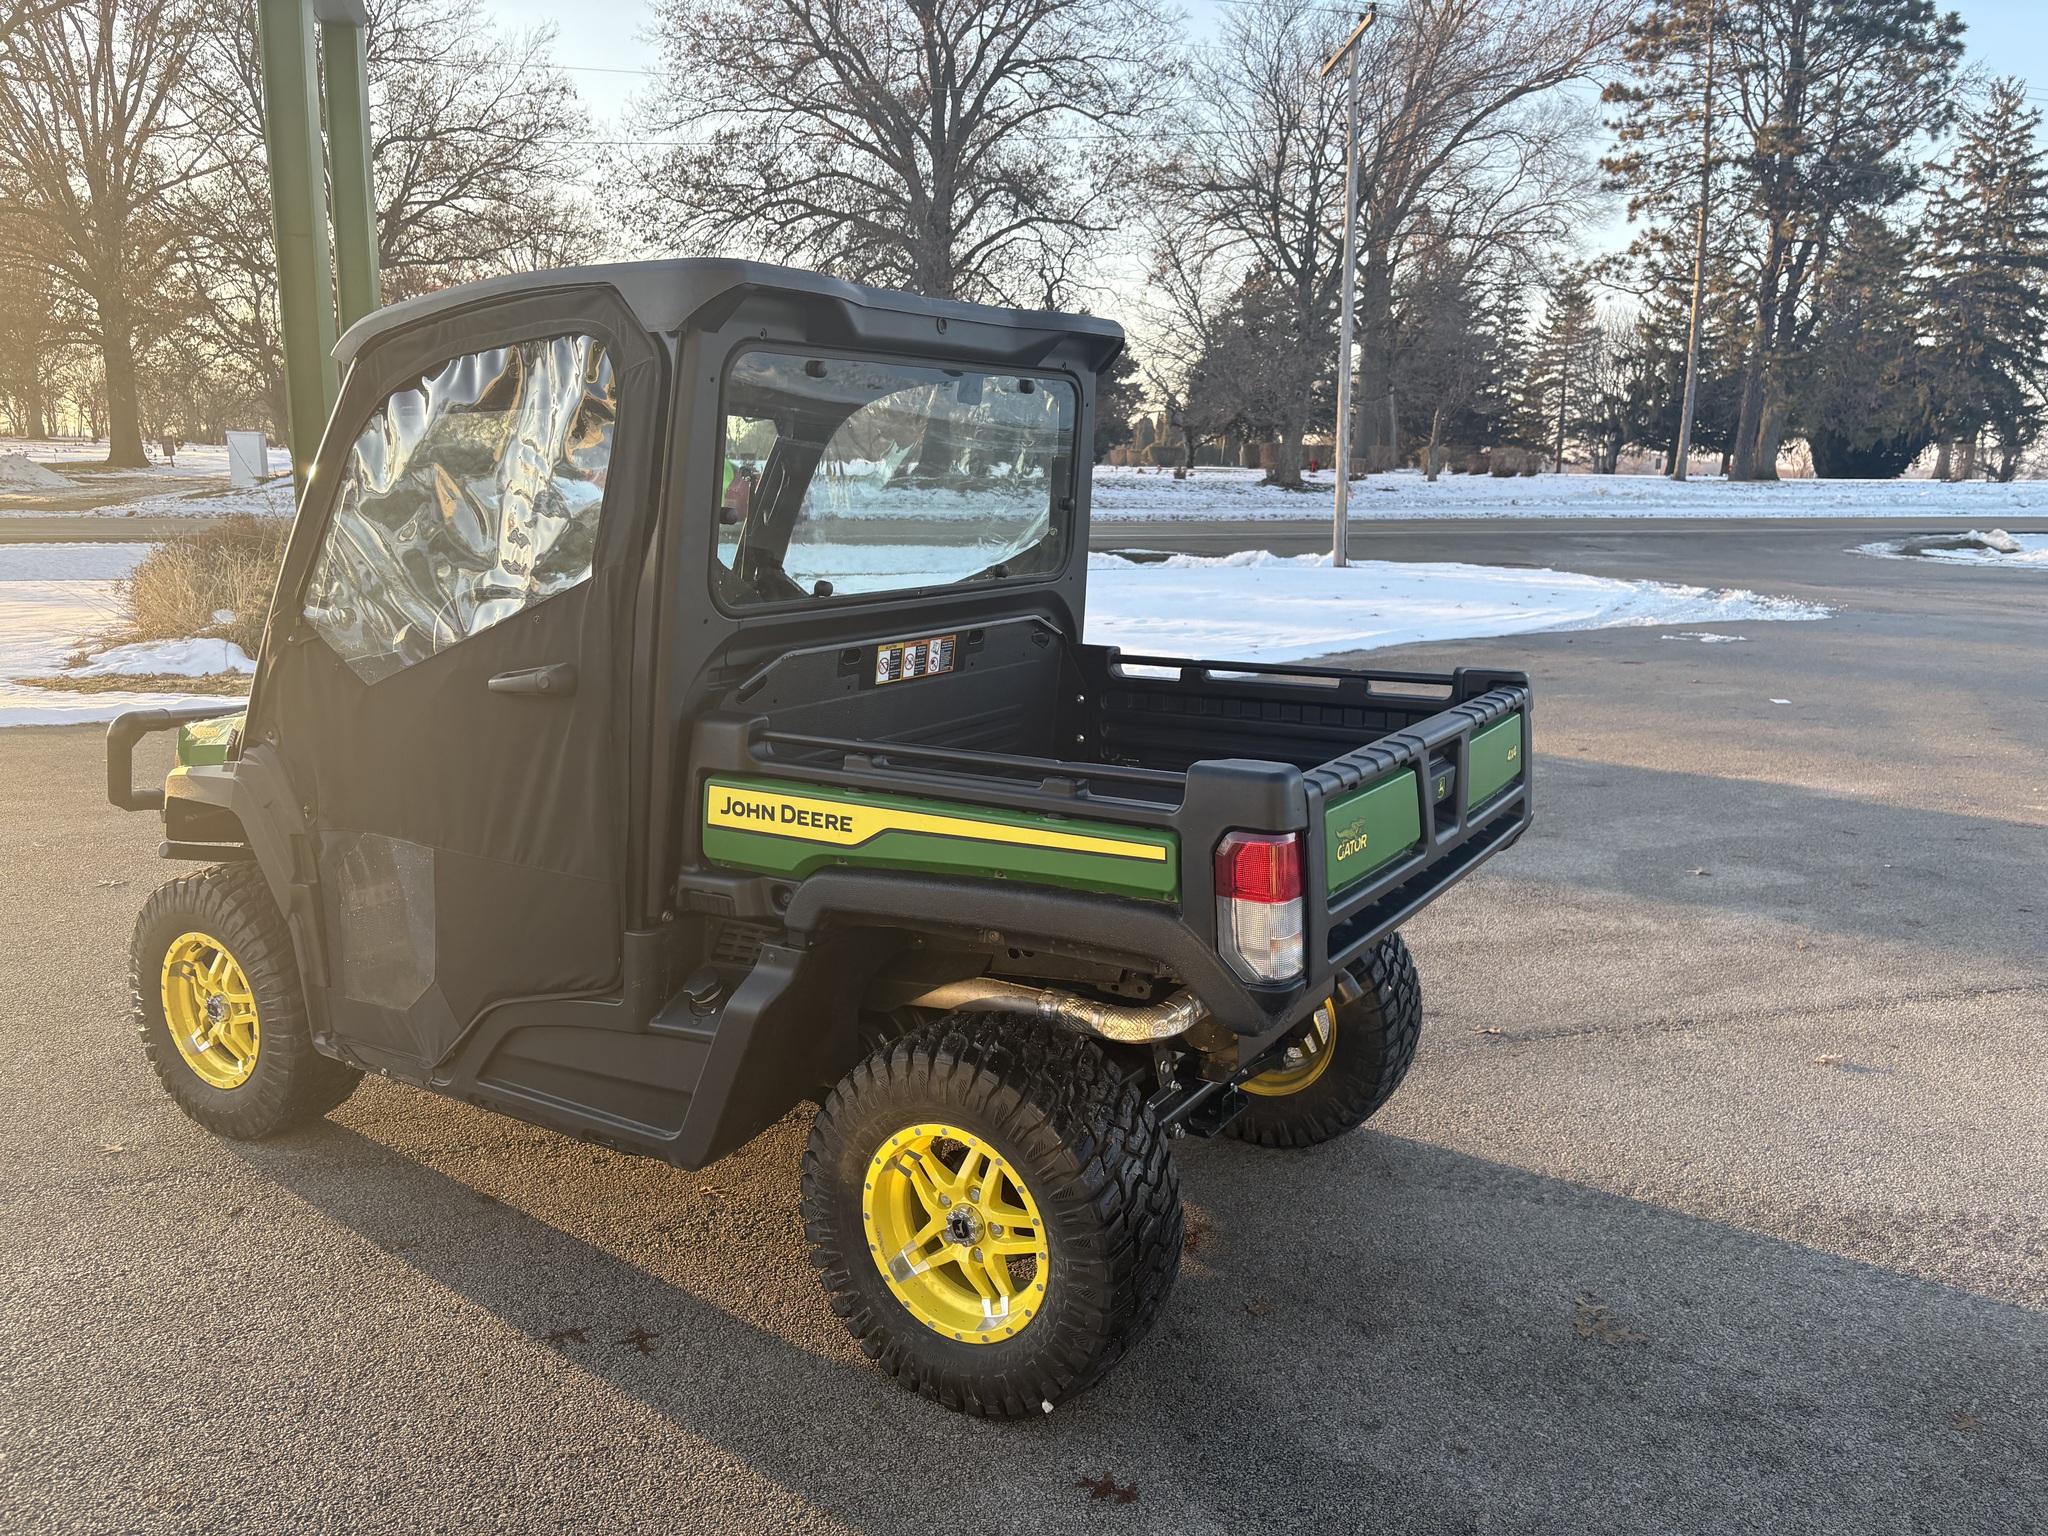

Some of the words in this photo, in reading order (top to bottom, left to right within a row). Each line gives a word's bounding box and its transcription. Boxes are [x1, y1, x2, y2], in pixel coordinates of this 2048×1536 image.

[720, 796, 776, 822] JOHN
[780, 803, 853, 833] DEERE
[1336, 833, 1368, 861] GATOR
